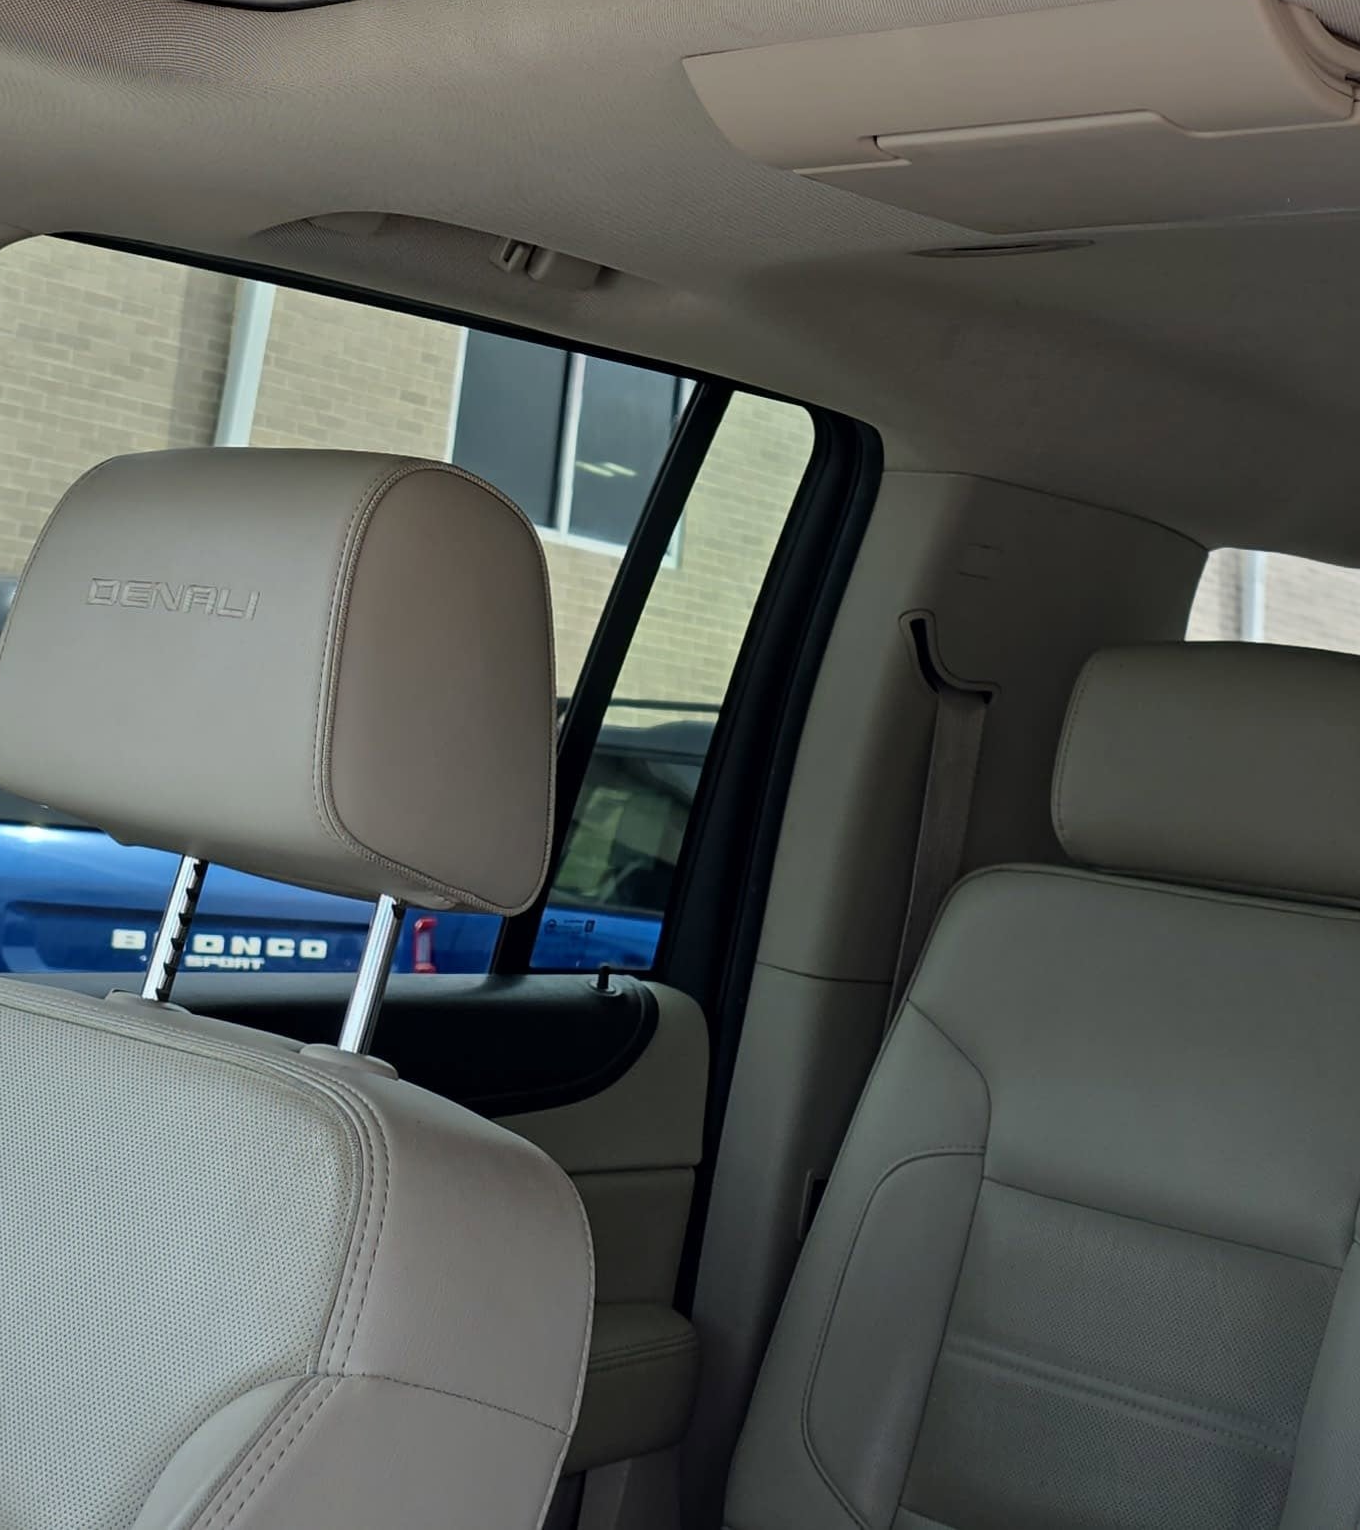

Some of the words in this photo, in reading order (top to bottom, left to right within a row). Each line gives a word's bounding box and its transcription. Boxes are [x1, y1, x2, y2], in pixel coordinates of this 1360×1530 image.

[88, 577, 260, 621] DENALI
[111, 928, 328, 959] BONCO
[185, 954, 265, 970] SPORT
